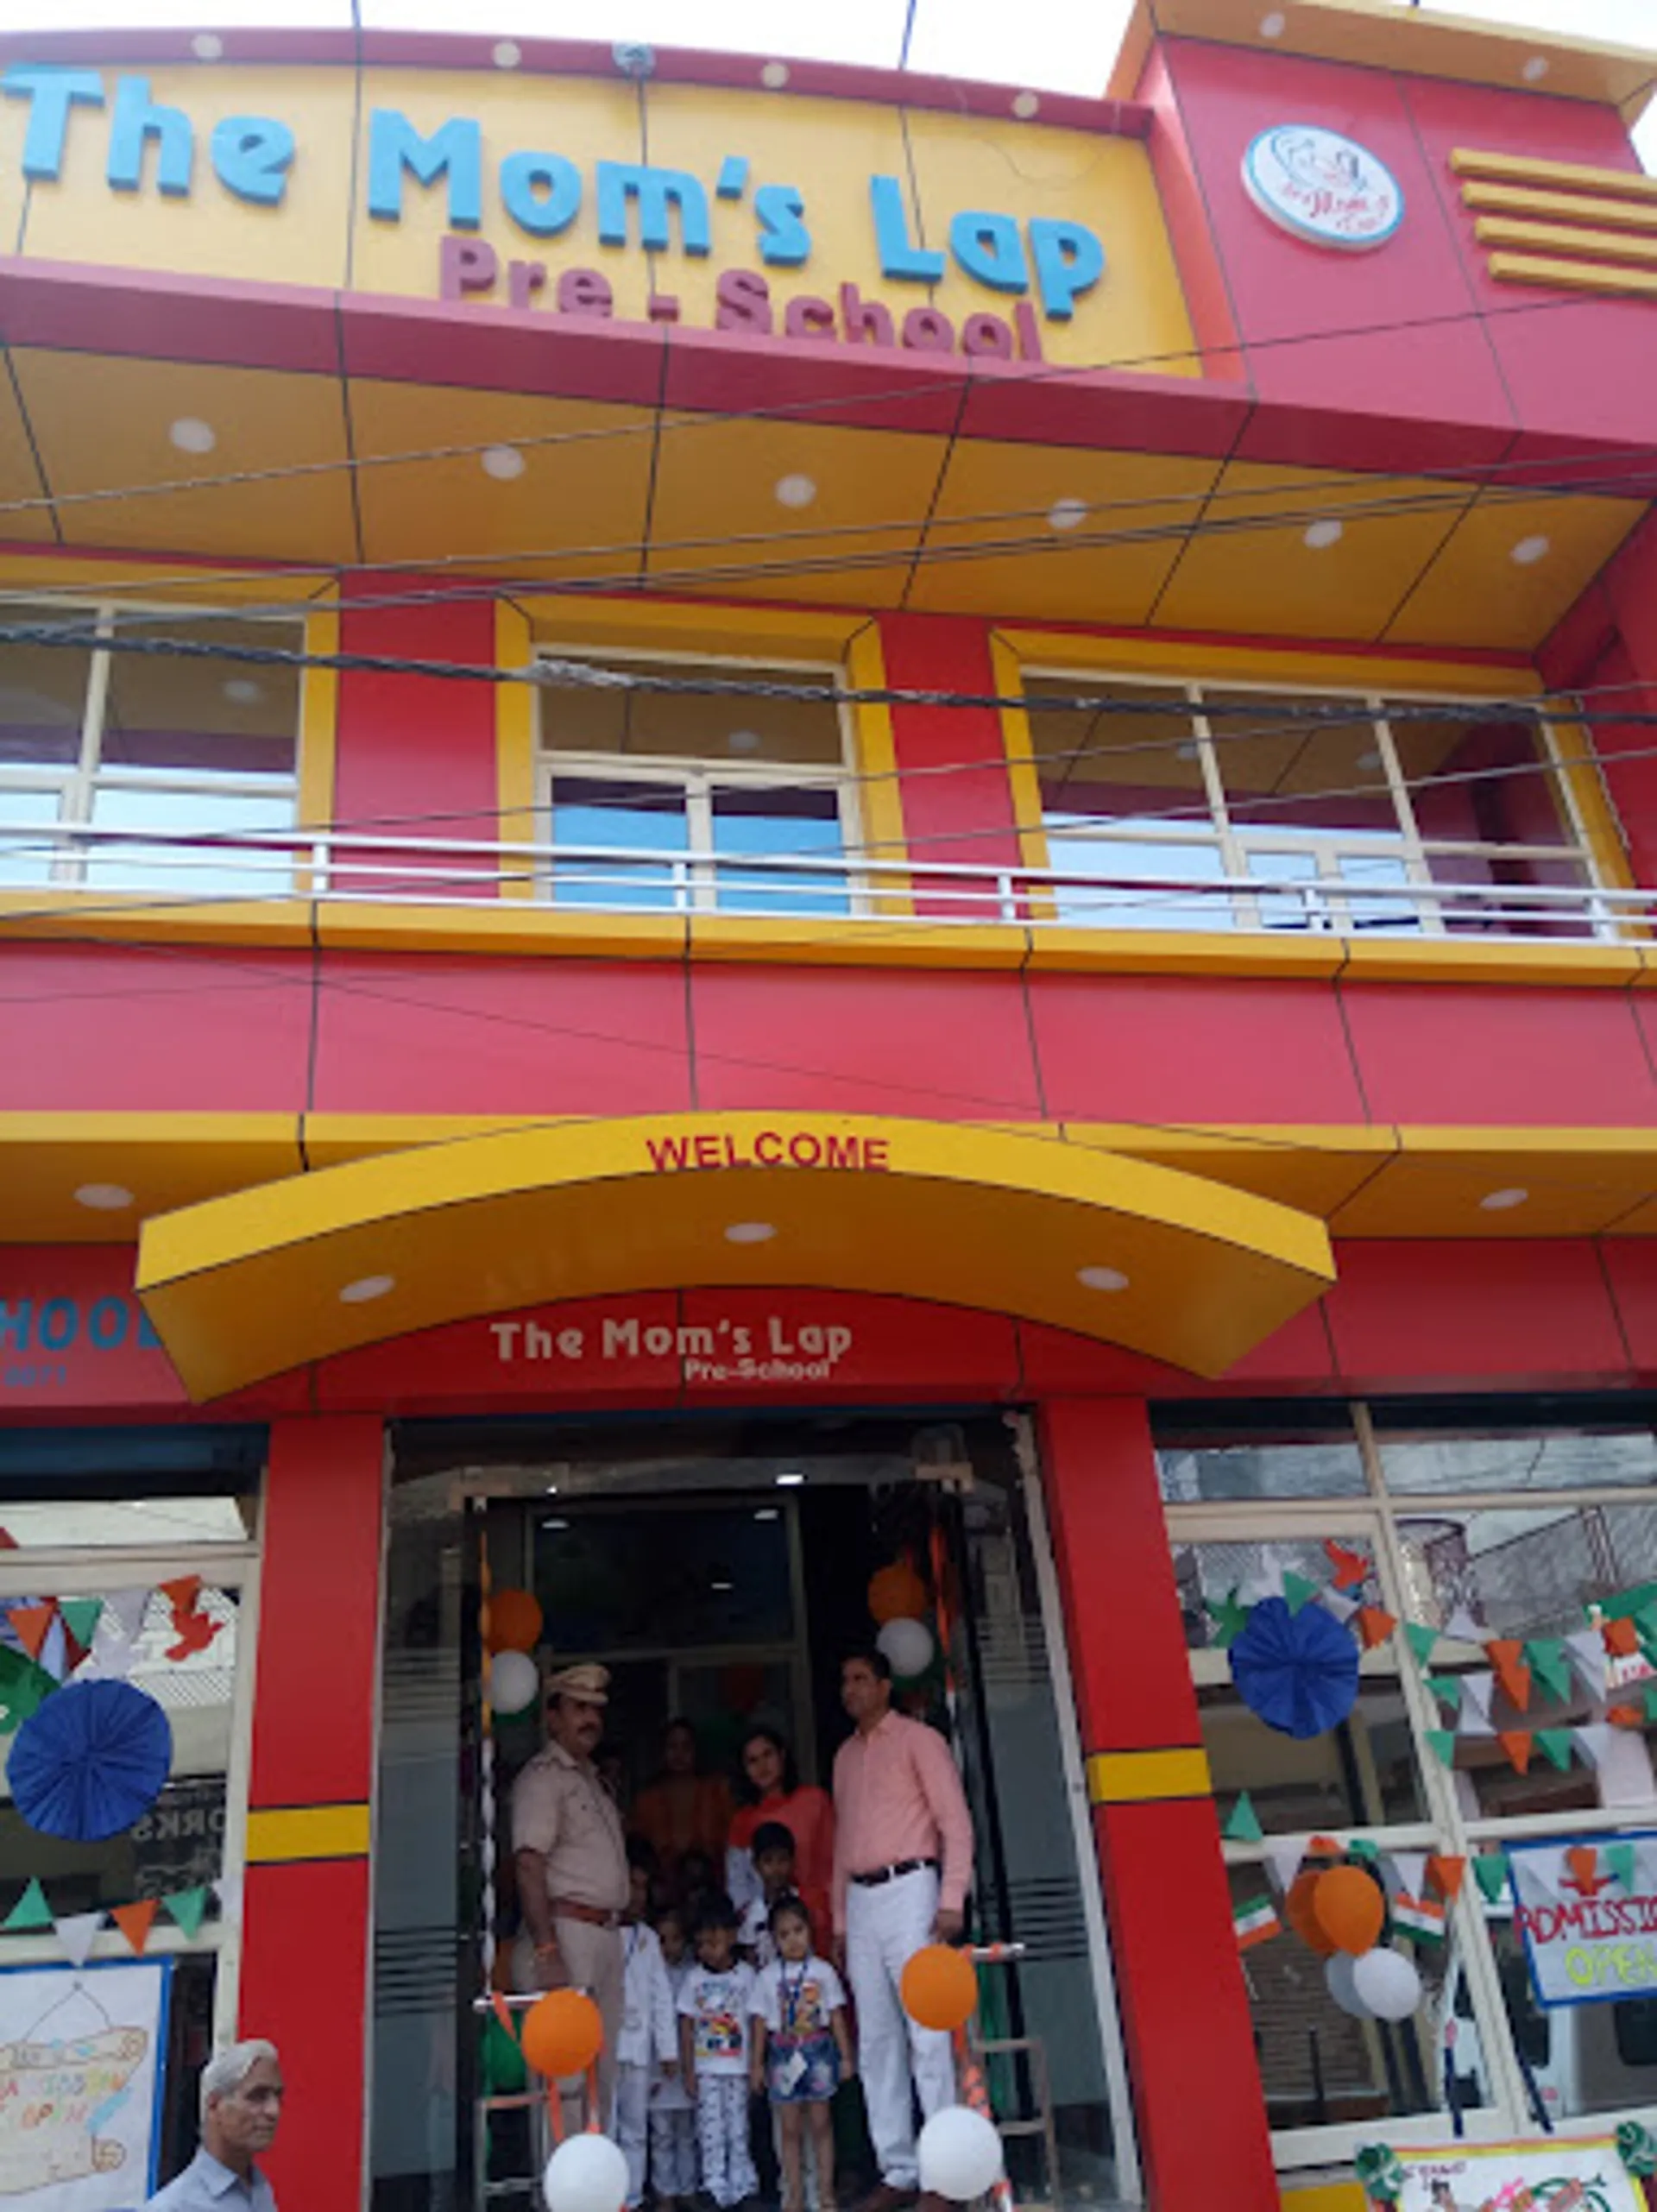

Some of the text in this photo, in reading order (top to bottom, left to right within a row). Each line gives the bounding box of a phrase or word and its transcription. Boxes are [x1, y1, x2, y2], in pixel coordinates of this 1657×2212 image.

[2, 62, 1106, 321] The Mom's Lap
[439, 234, 613, 318] Pre
[715, 268, 1043, 362] School
[646, 1131, 891, 1173] WELCOME
[489, 1315, 853, 1363] The Mom's Lap
[684, 1357, 830, 1381] Pre-School
